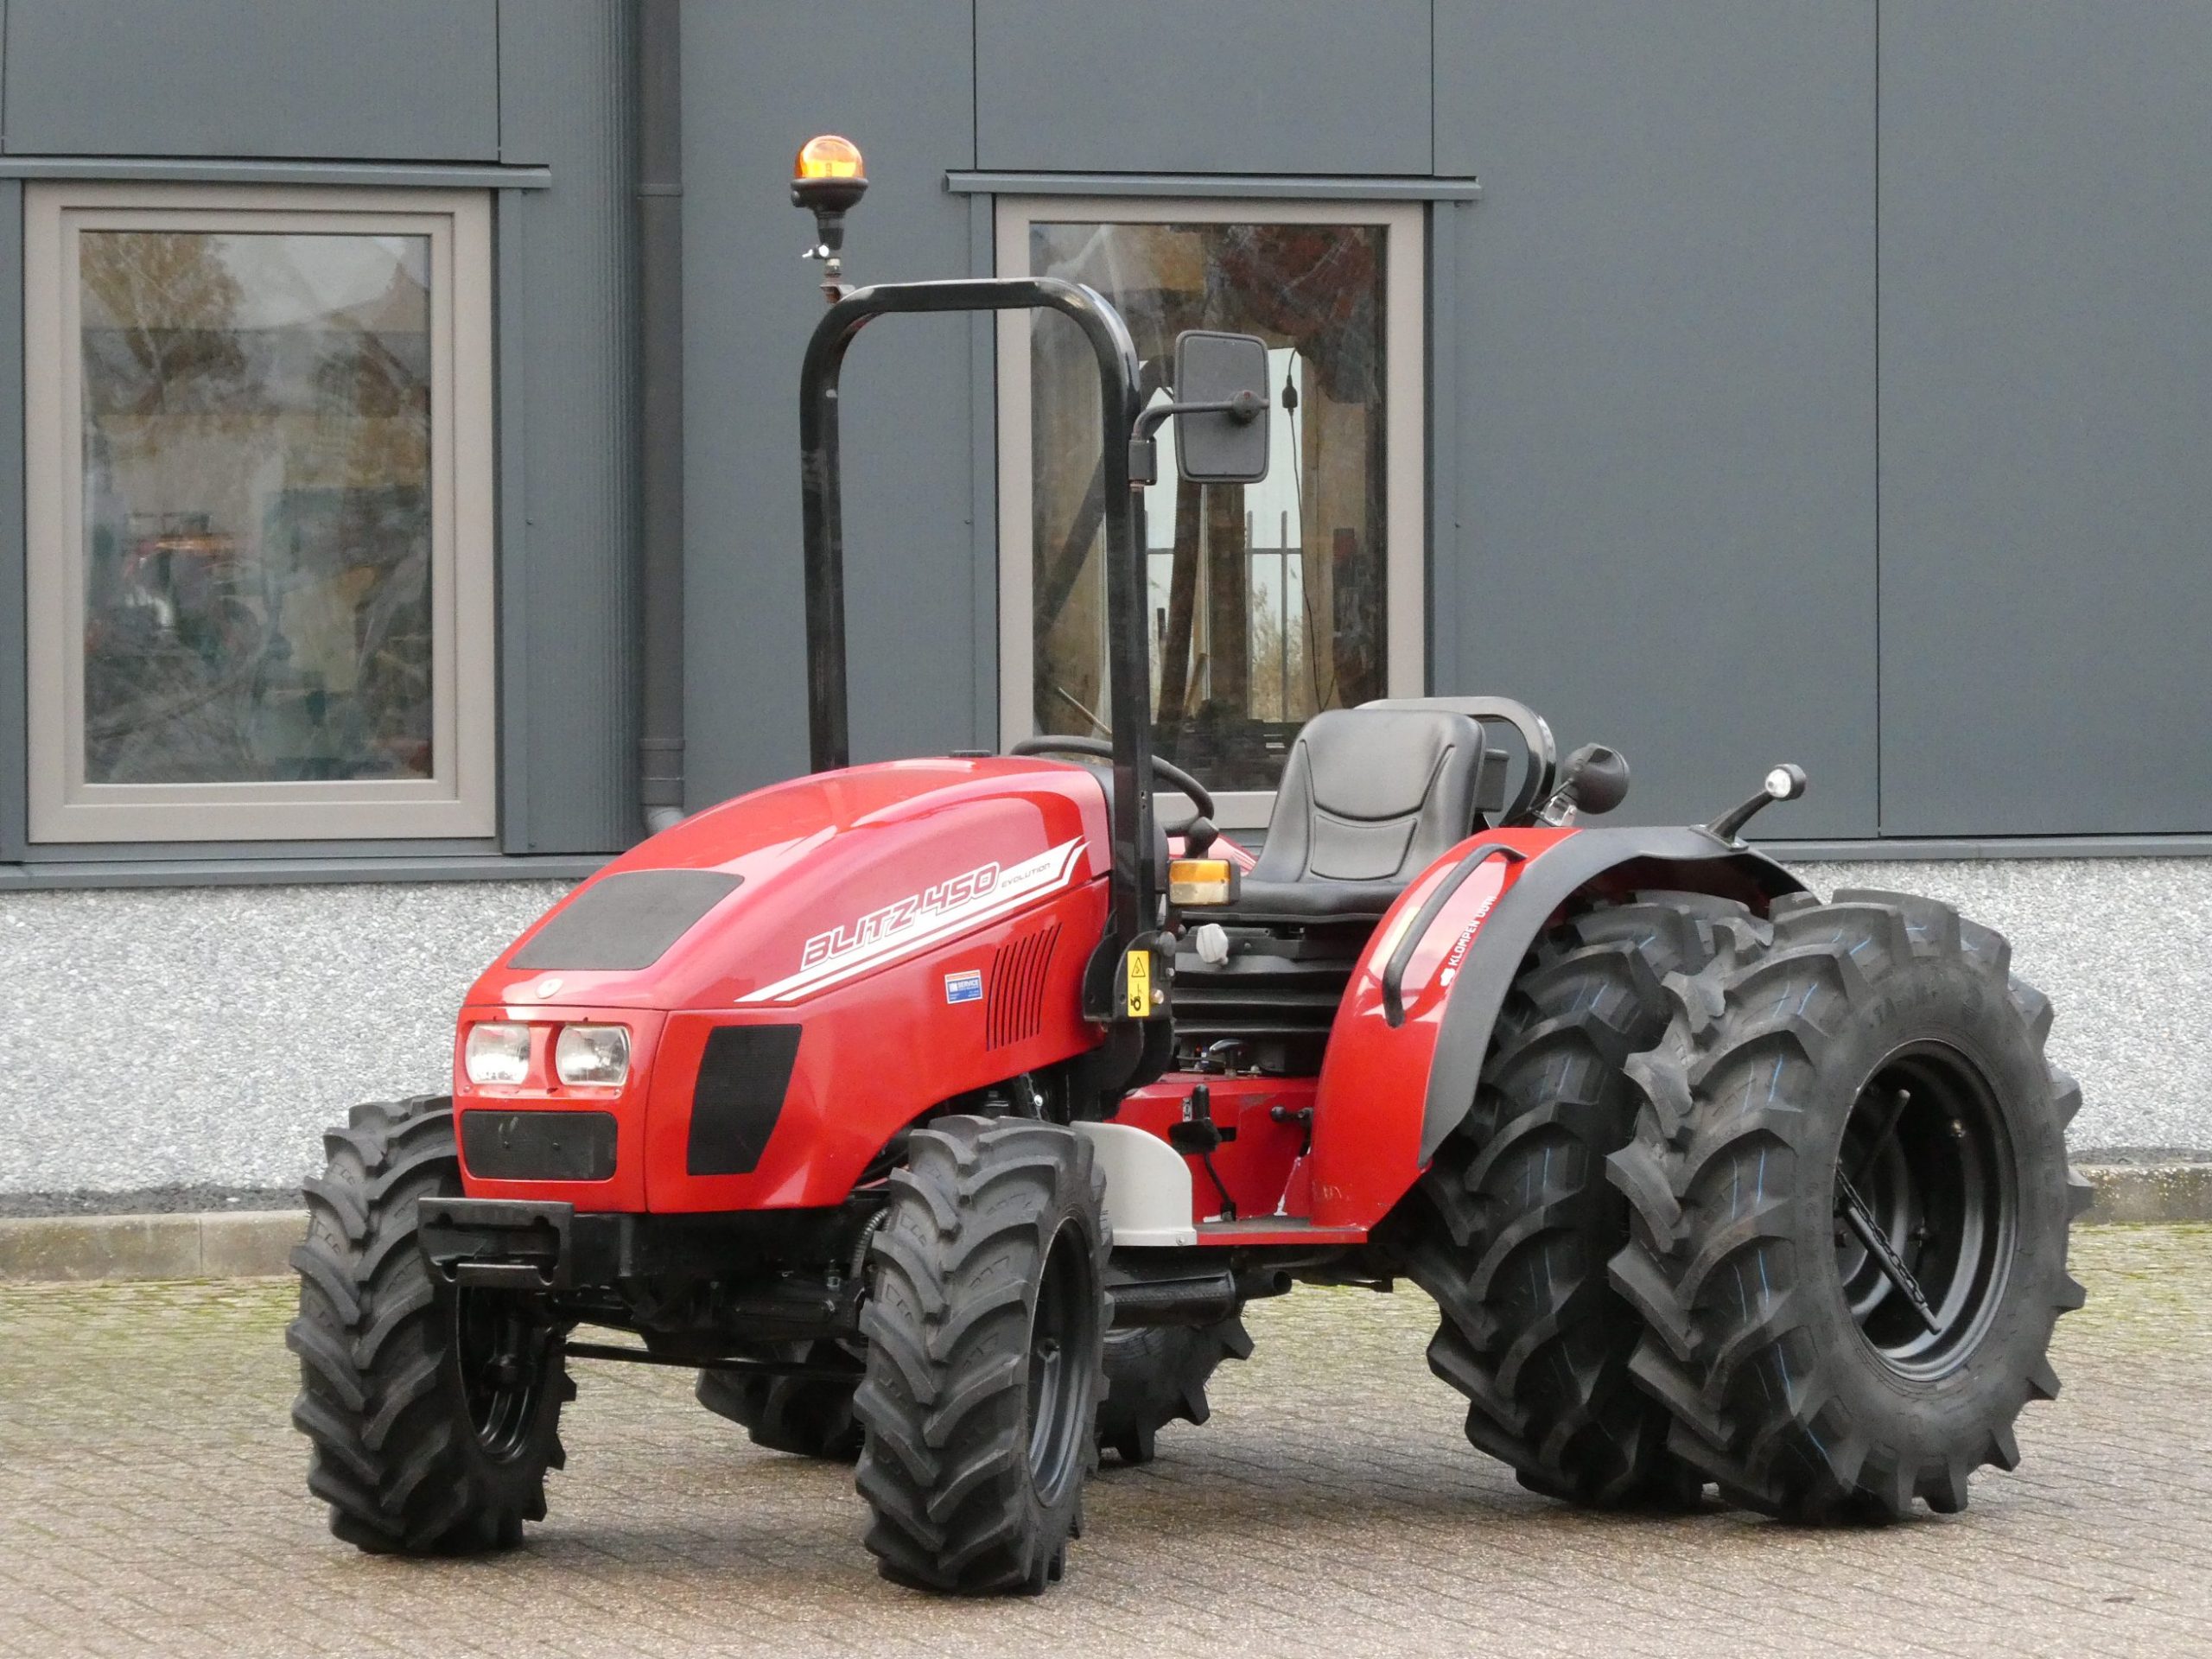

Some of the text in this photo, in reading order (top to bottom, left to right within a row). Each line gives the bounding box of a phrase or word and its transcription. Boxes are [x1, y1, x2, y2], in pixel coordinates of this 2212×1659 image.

[801, 895, 918, 969] BLITZ
[921, 862, 1000, 914] 450
[1447, 920, 1480, 966] KLOMPEN
